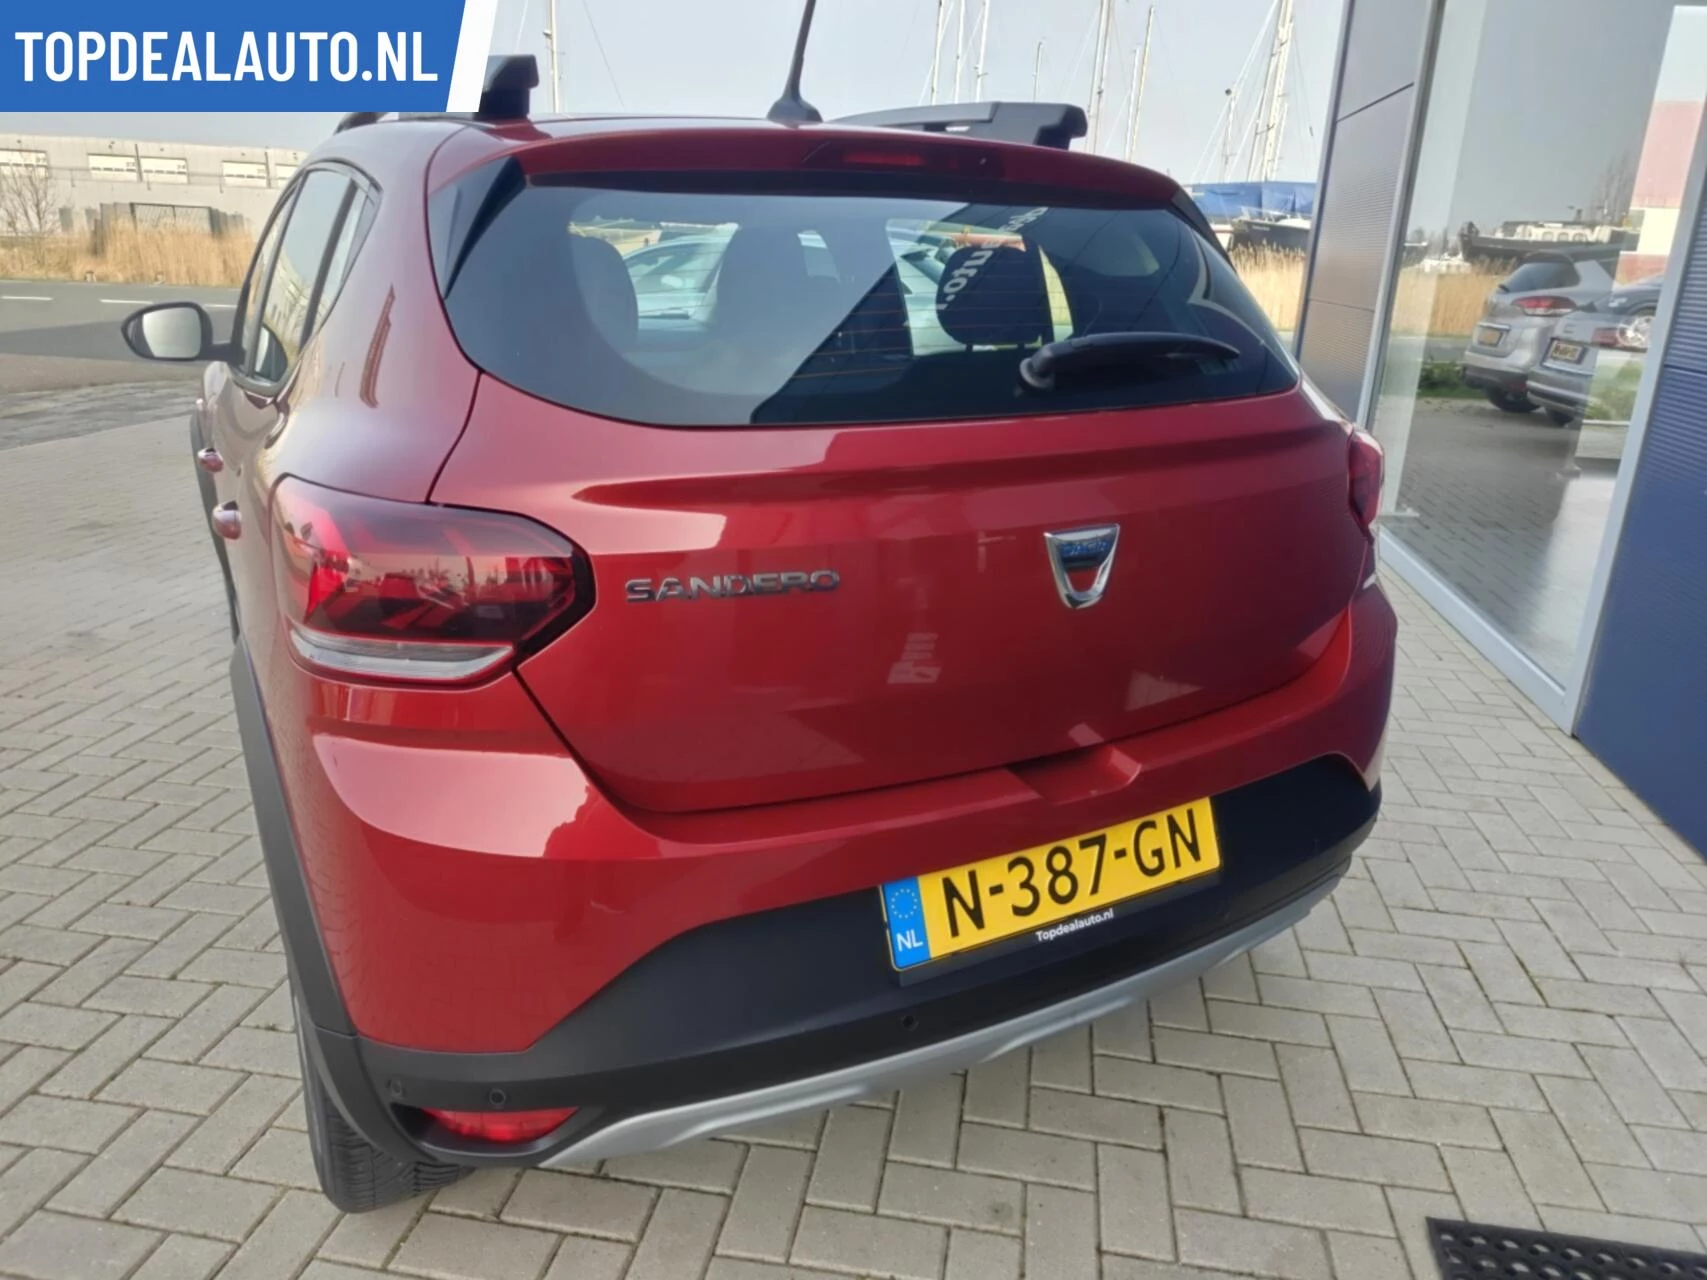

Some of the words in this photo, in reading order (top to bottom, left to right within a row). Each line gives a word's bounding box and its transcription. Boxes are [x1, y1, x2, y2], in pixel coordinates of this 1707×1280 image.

[625, 569, 840, 603] SANDERO
[942, 808, 1201, 937] N-387-GN
[896, 929, 923, 952] NL
[1035, 908, 1114, 942] Topdealauto.nl
